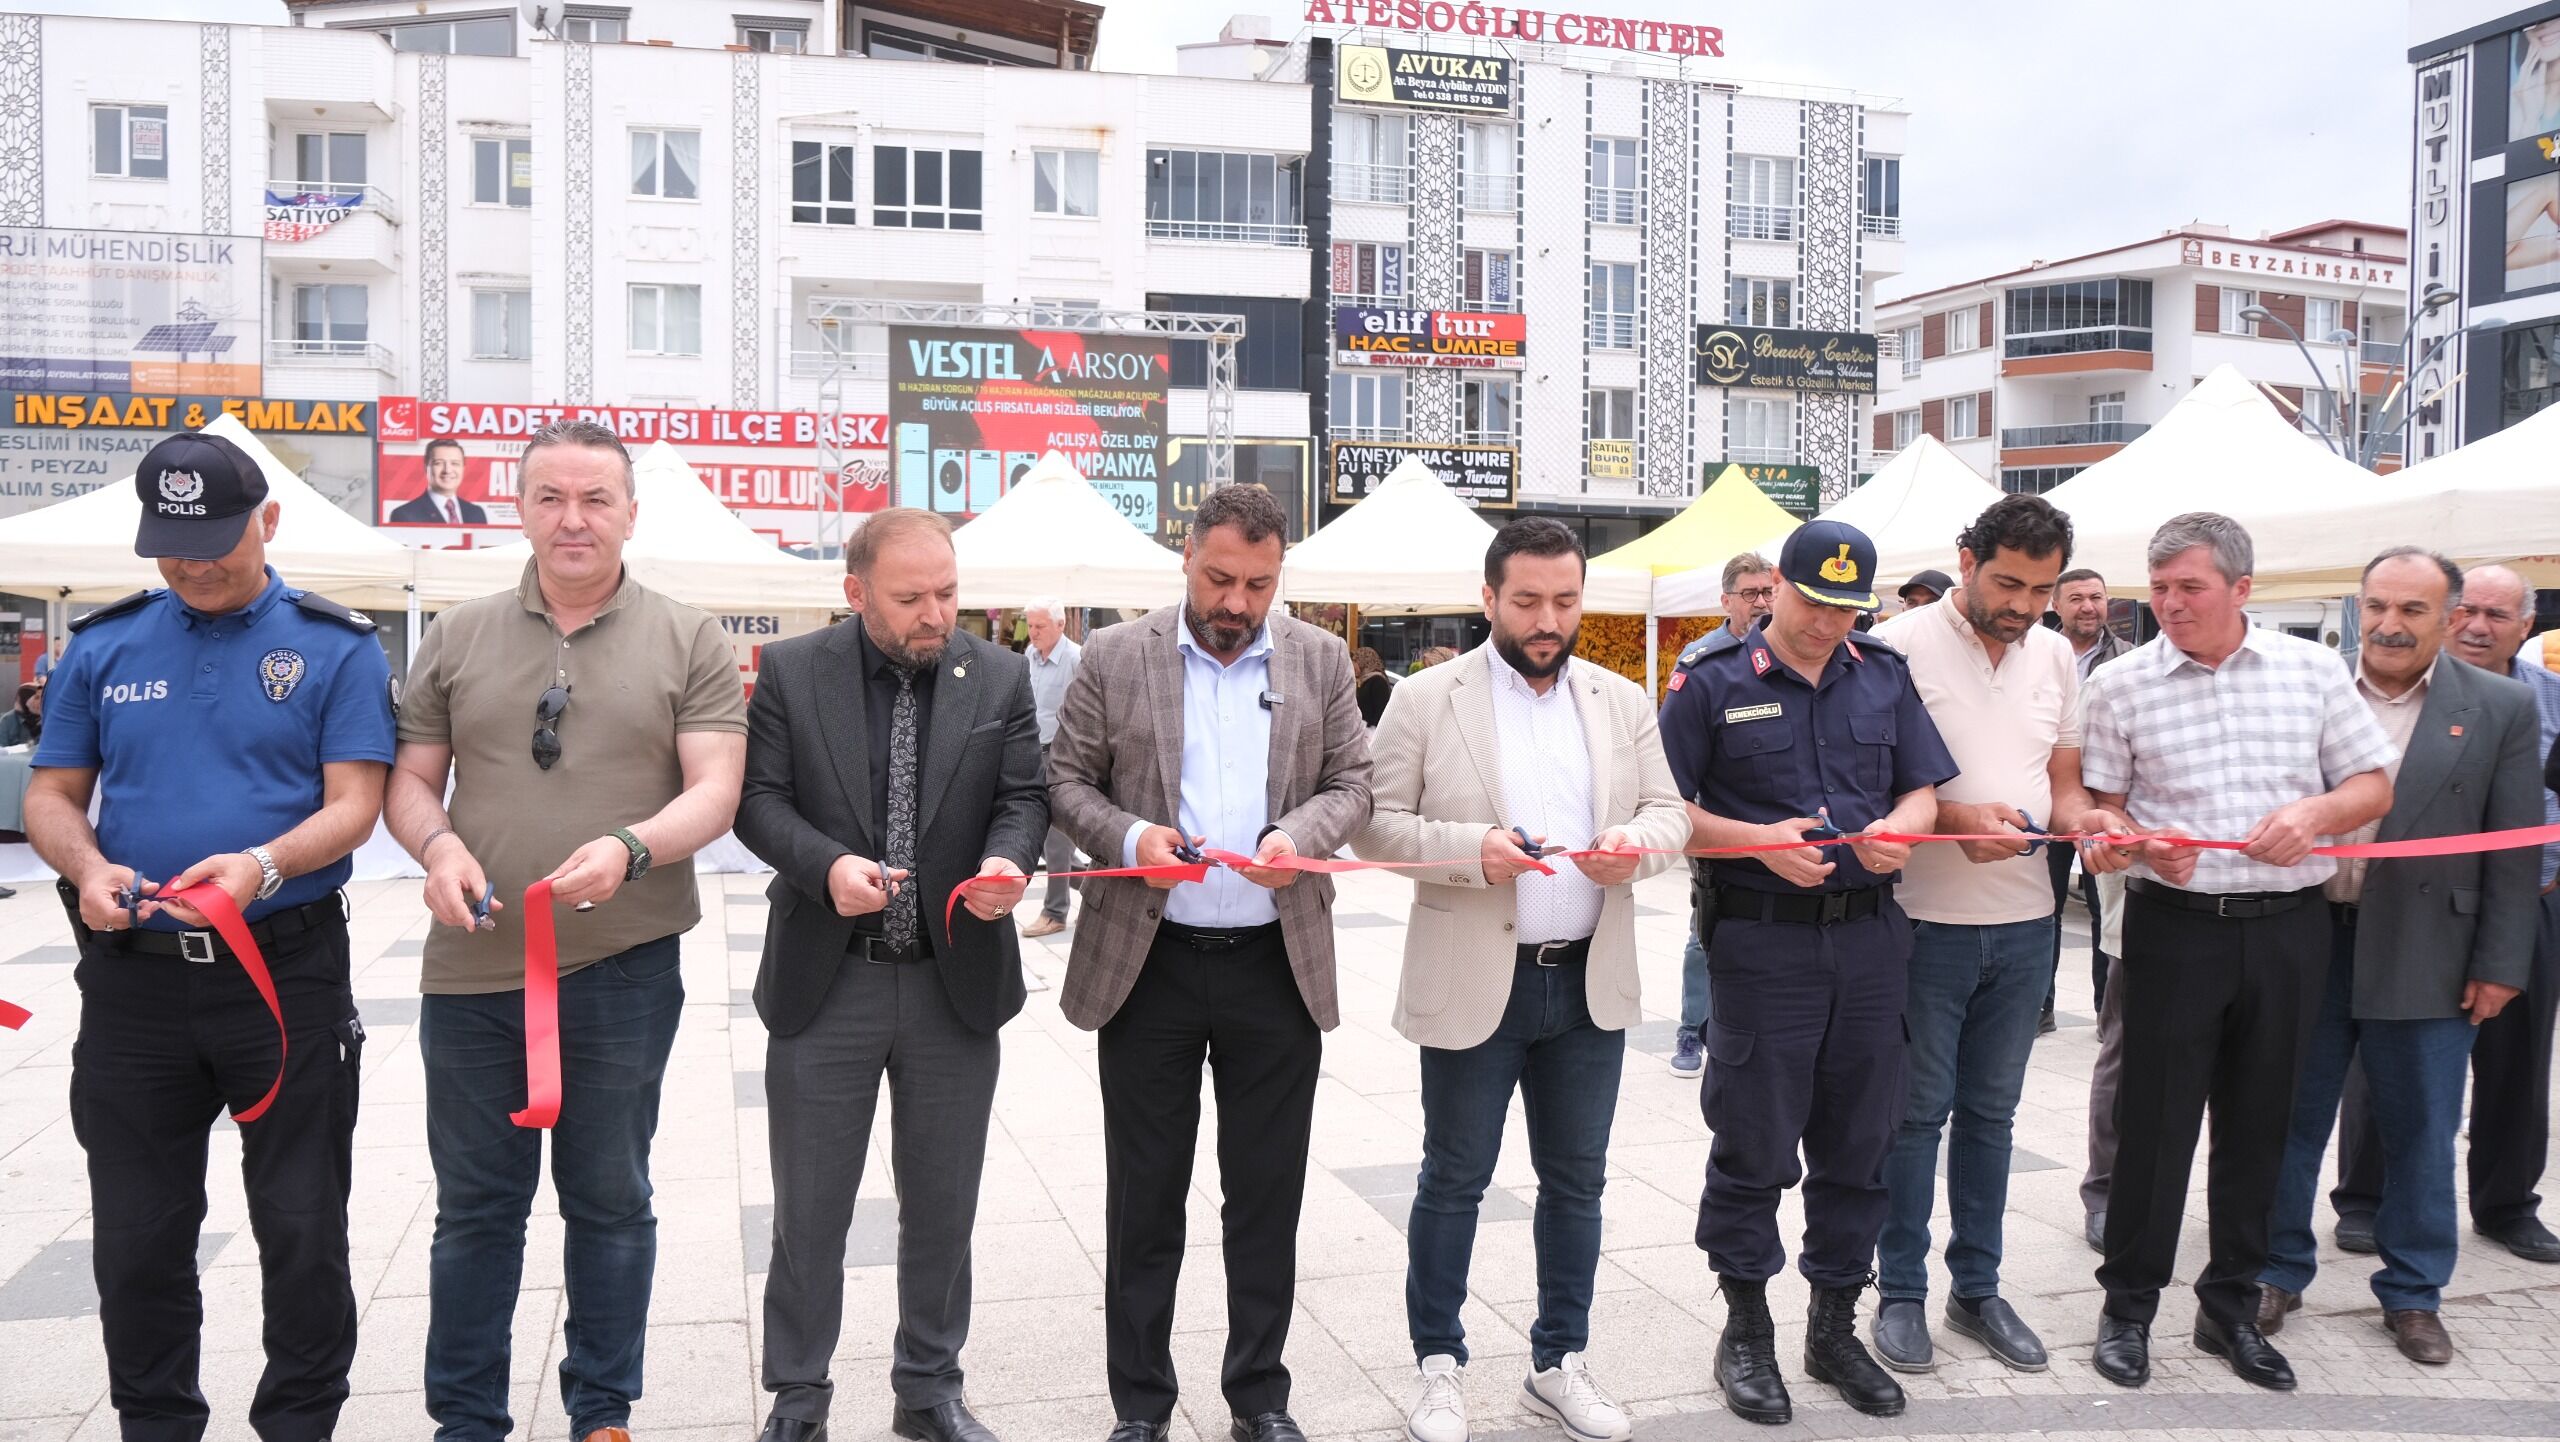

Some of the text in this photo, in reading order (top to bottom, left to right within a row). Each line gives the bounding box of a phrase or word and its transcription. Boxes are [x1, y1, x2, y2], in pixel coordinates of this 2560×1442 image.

[1555, 13, 1724, 57] CENTER
[1396, 53, 1502, 81] AVUKAT
[1393, 76, 1507, 94] Av. Beyza Aybüke AYDIN
[1436, 92, 1452, 101] 538
[1454, 94, 1468, 102] 815
[1482, 96, 1493, 105] 05
[2424, 70, 2450, 227] MUTLU
[48, 233, 234, 265] MÜHENDİSLİK
[115, 267, 219, 283] DANIŞMANLIK
[1361, 250, 1373, 295] UMRE
[1385, 248, 1398, 295] HAC
[1364, 311, 1427, 334] elif
[1436, 313, 1495, 336] tur
[1349, 335, 1410, 352] HAC
[1431, 338, 1517, 356] UMRE
[1753, 333, 1874, 368] Beauty Center
[909, 339, 1022, 380] VESTEL
[1066, 351, 1154, 381] ARSOY
[1369, 354, 1429, 367] SEYAHAT
[1432, 355, 1495, 368] ACENTASI
[942, 384, 973, 394] SORGUN
[1751, 374, 1783, 387] Estetik
[1786, 376, 1794, 387] &
[1837, 379, 1873, 391] Merkezi
[15, 394, 366, 432] İNŞAAT & EMLAK
[922, 396, 1141, 418] BÜYÜK AÇILIŞ FIRSATLARI SİZLERİ BEKLİYOR
[430, 406, 564, 434] SAADET
[577, 409, 699, 439] PARTİSİ
[711, 412, 783, 444] İLÇE
[78, 434, 155, 455] İNŞAAT
[1100, 430, 1131, 448] ÖZEL
[1134, 434, 1158, 449] DEV
[1592, 443, 1631, 453] SATILIK
[31, 459, 107, 474] PEYZAJ
[1064, 451, 1157, 478] AMPANYA
[1338, 447, 1407, 464] AYNEYN
[754, 469, 826, 506] OLUR
[158, 502, 206, 516] POLİS
[102, 680, 168, 705] POLİS
